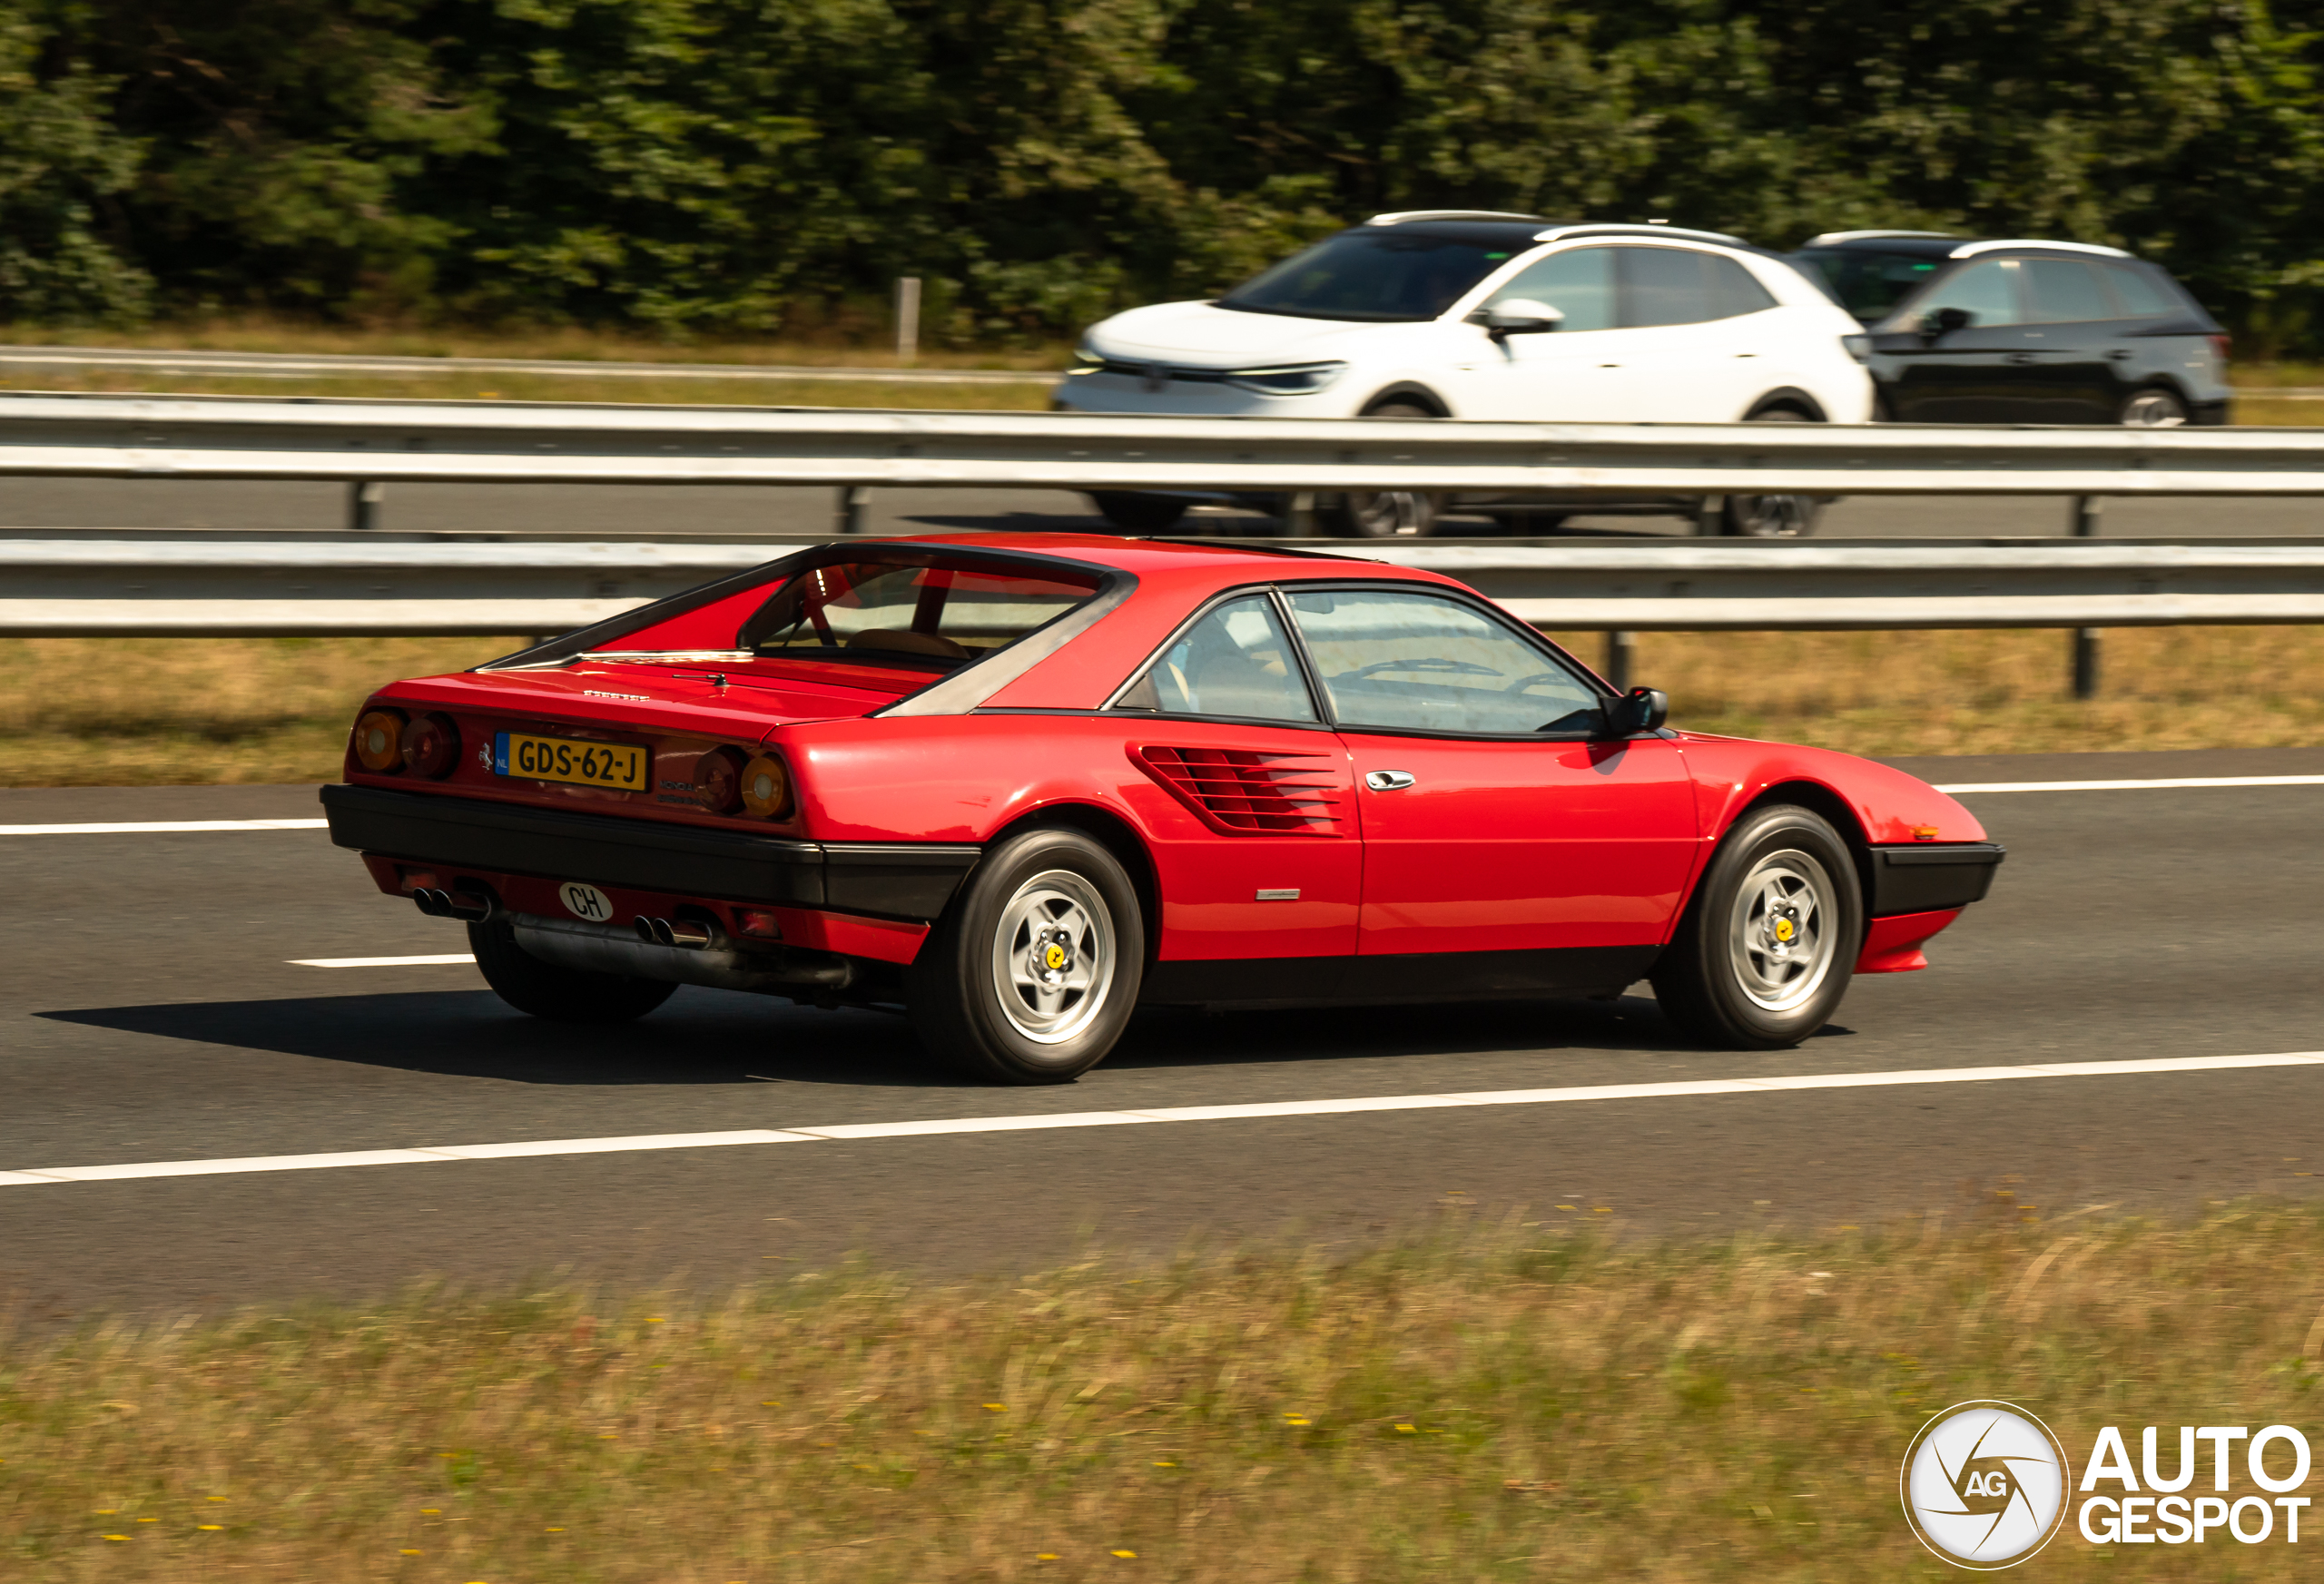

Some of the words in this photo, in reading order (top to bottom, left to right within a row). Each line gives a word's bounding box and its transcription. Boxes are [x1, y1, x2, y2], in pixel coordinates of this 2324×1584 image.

[497, 759, 507, 768] NL
[518, 741, 636, 783] GDS-62-J
[568, 887, 604, 918] CH
